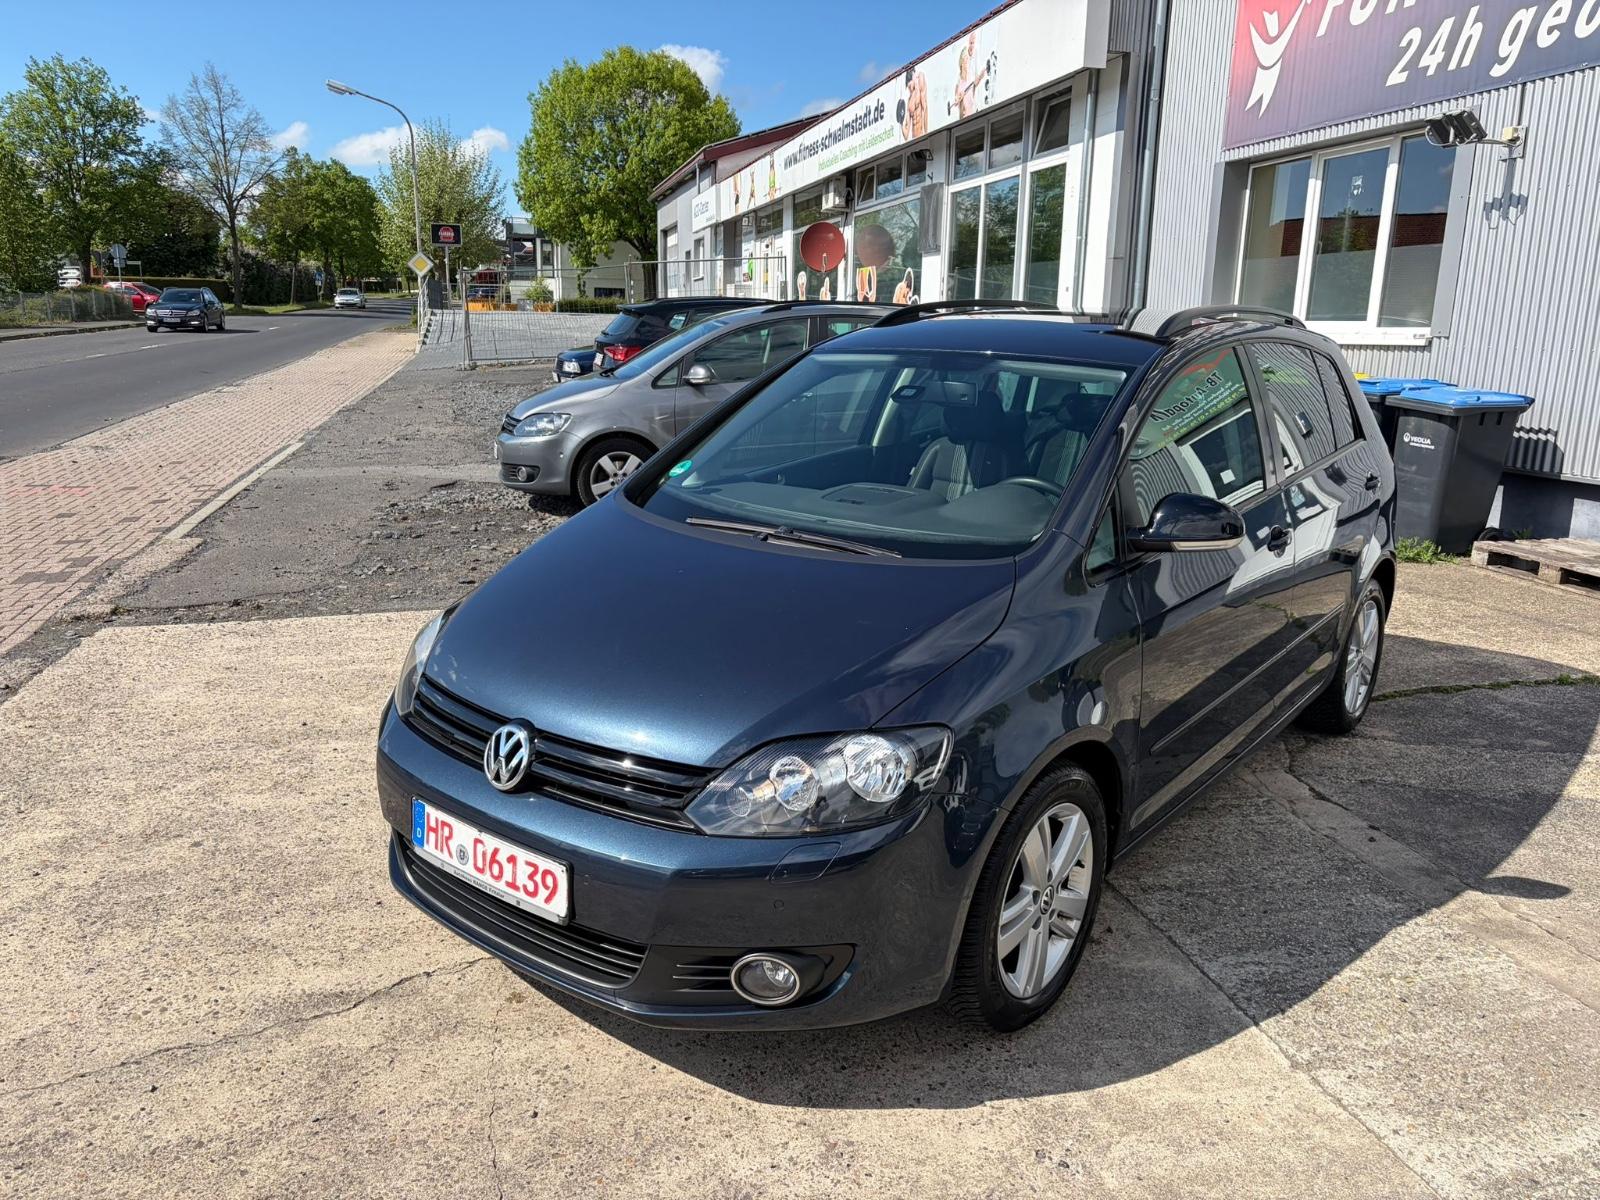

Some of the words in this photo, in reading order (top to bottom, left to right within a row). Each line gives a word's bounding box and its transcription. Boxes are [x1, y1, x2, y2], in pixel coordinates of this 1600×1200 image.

[1386, 5, 1484, 87] 24h
[784, 98, 885, 171] www.fitness-schwalmstadt.de
[1410, 436, 1431, 445] VEOLIA
[426, 811, 454, 860] HR
[473, 837, 559, 905] 06139
